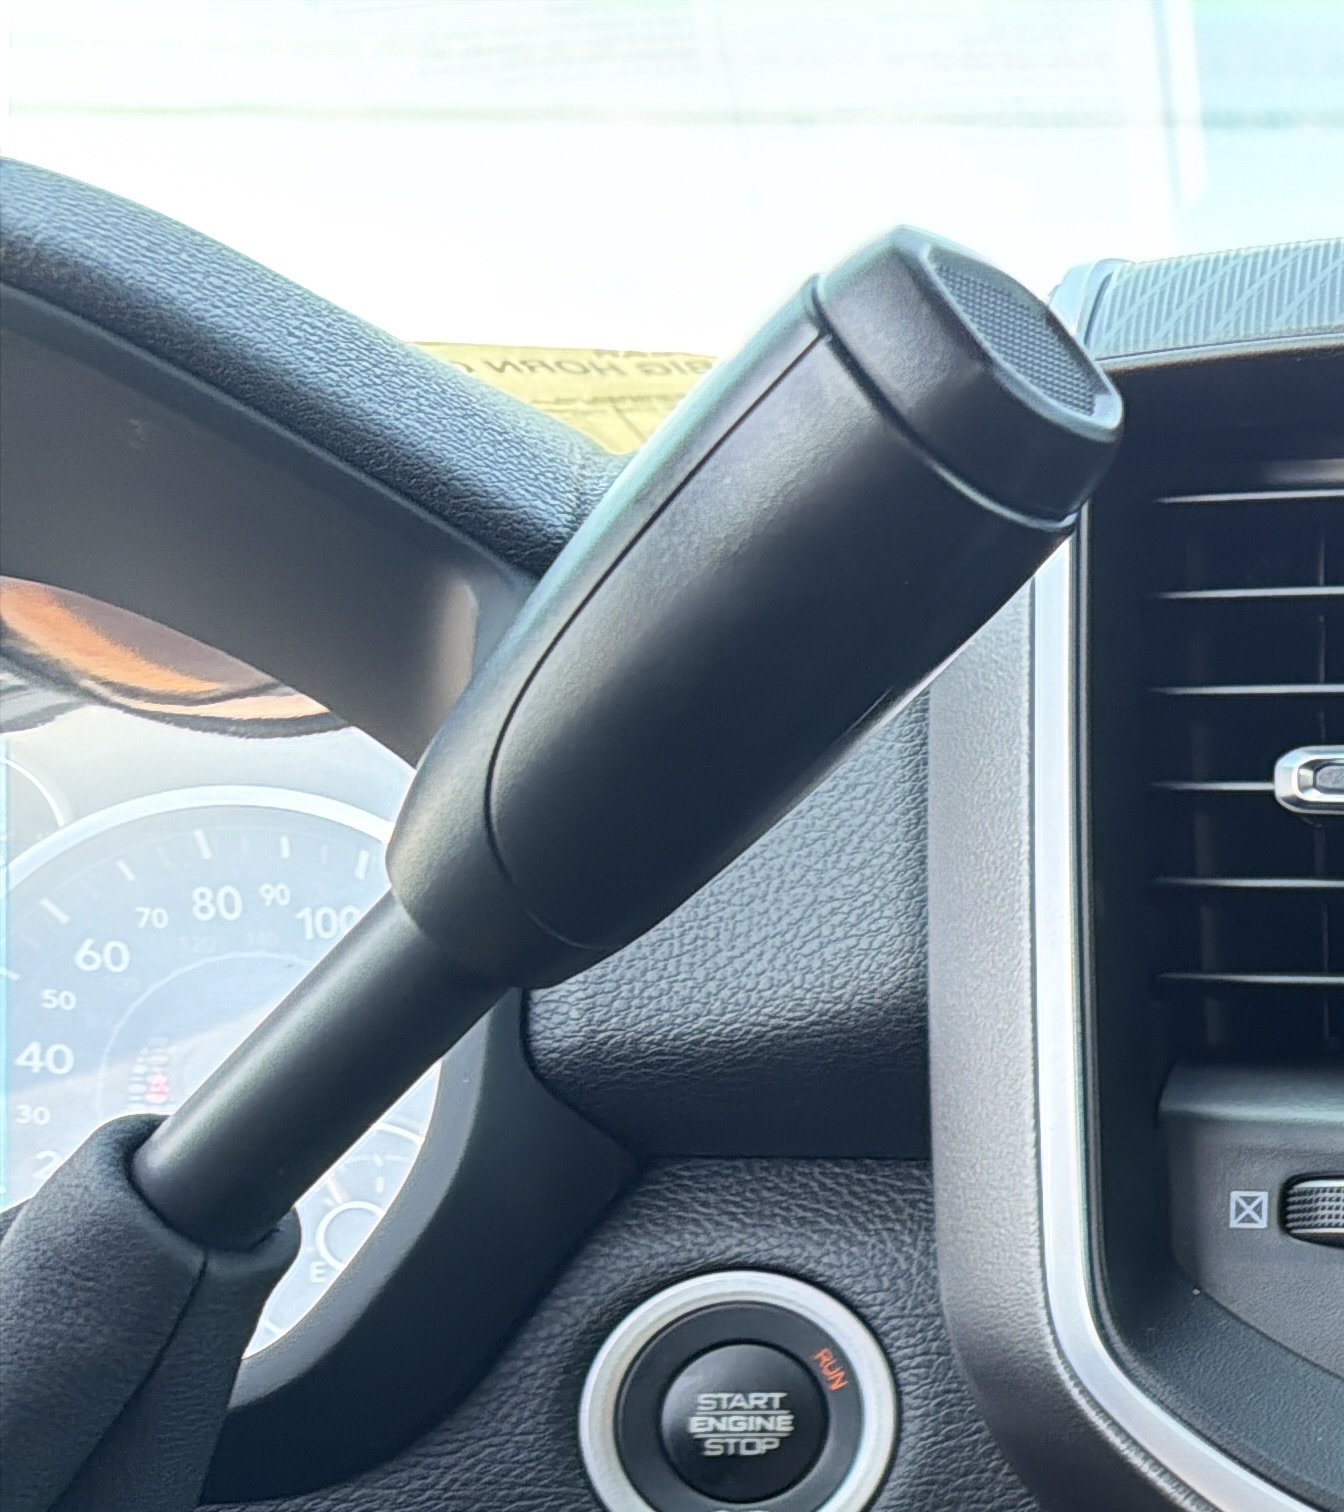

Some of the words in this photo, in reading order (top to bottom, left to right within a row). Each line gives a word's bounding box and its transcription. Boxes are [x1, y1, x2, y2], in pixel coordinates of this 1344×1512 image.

[191, 885, 243, 922] 80
[259, 883, 292, 907] 90
[135, 907, 170, 929] 70
[74, 938, 131, 973] 60
[41, 990, 78, 1011] 50
[14, 1041, 74, 1074] 40
[15, 1105, 52, 1126] 30
[32, 1149, 61, 1181] 2
[311, 1261, 327, 1283] E
[813, 1347, 849, 1392] RUN
[698, 1392, 787, 1411] START
[689, 1414, 794, 1434] ENGINE
[703, 1437, 780, 1456] STOP
